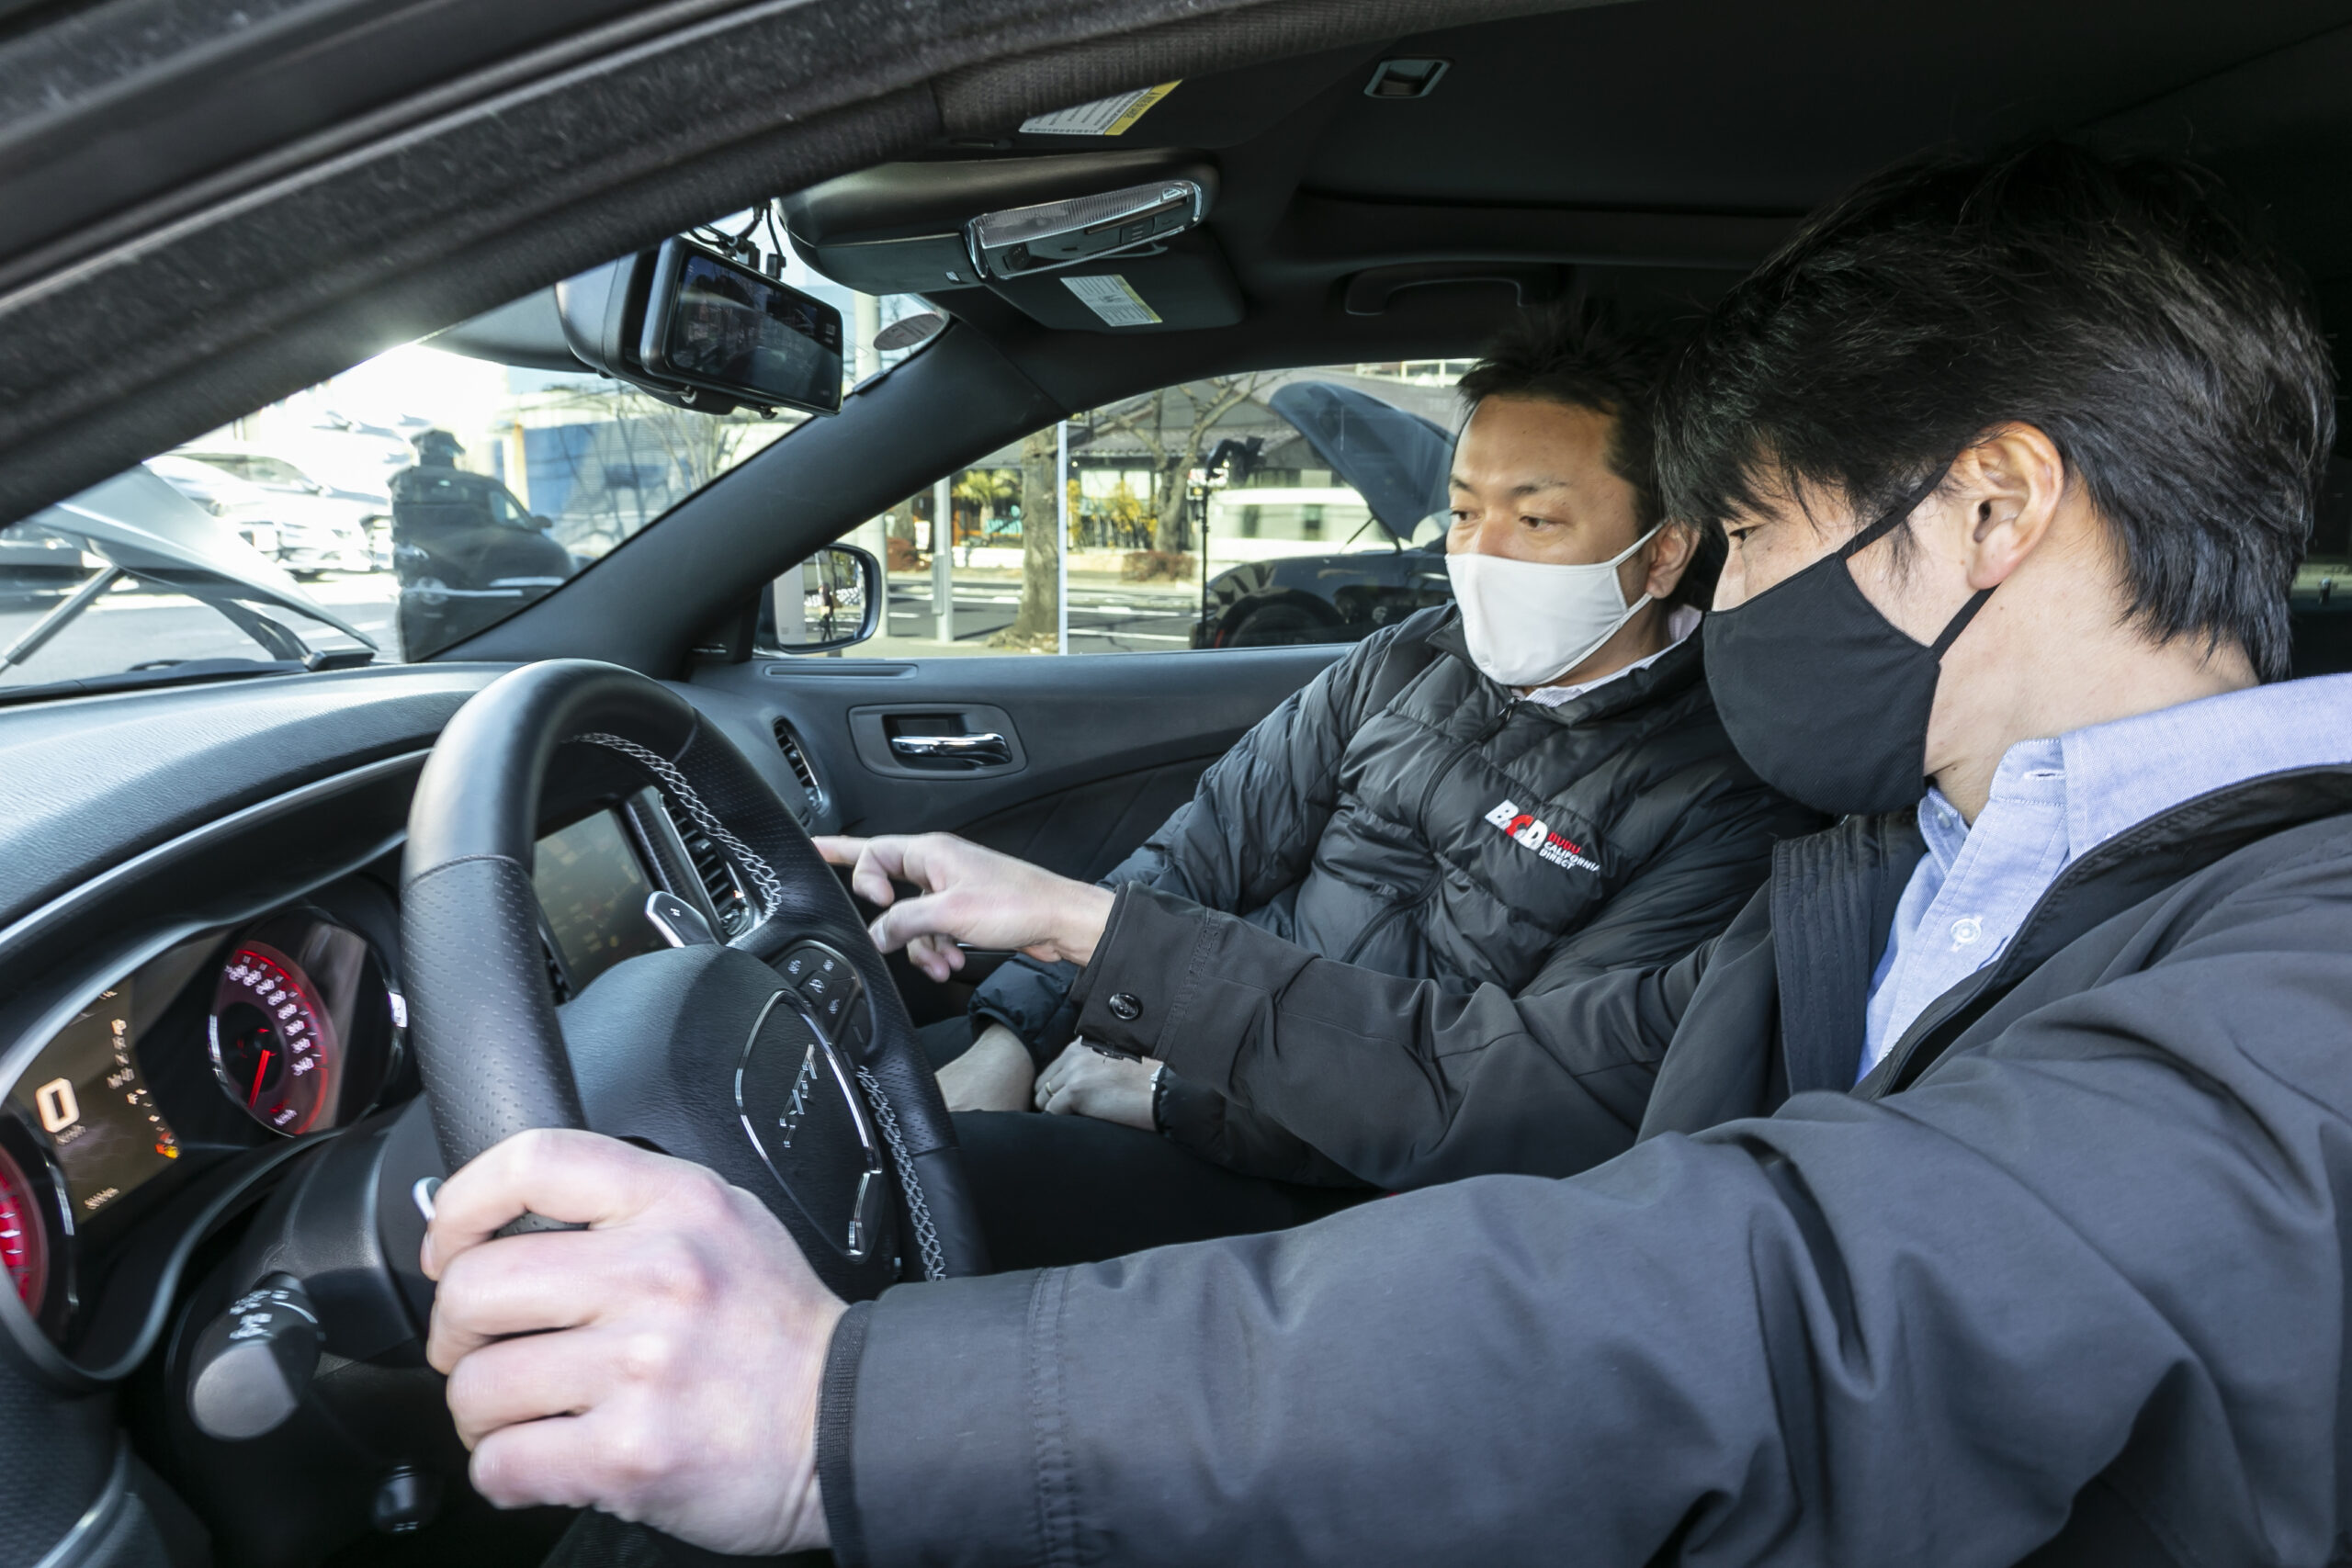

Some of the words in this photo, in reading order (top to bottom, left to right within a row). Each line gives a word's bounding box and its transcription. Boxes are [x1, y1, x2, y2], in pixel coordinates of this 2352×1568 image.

[1485, 799, 1548, 851] BCD
[1539, 848, 1576, 870] DIRECT
[1544, 841, 1600, 872] CALIFORNIA
[35, 1077, 80, 1133] 0
